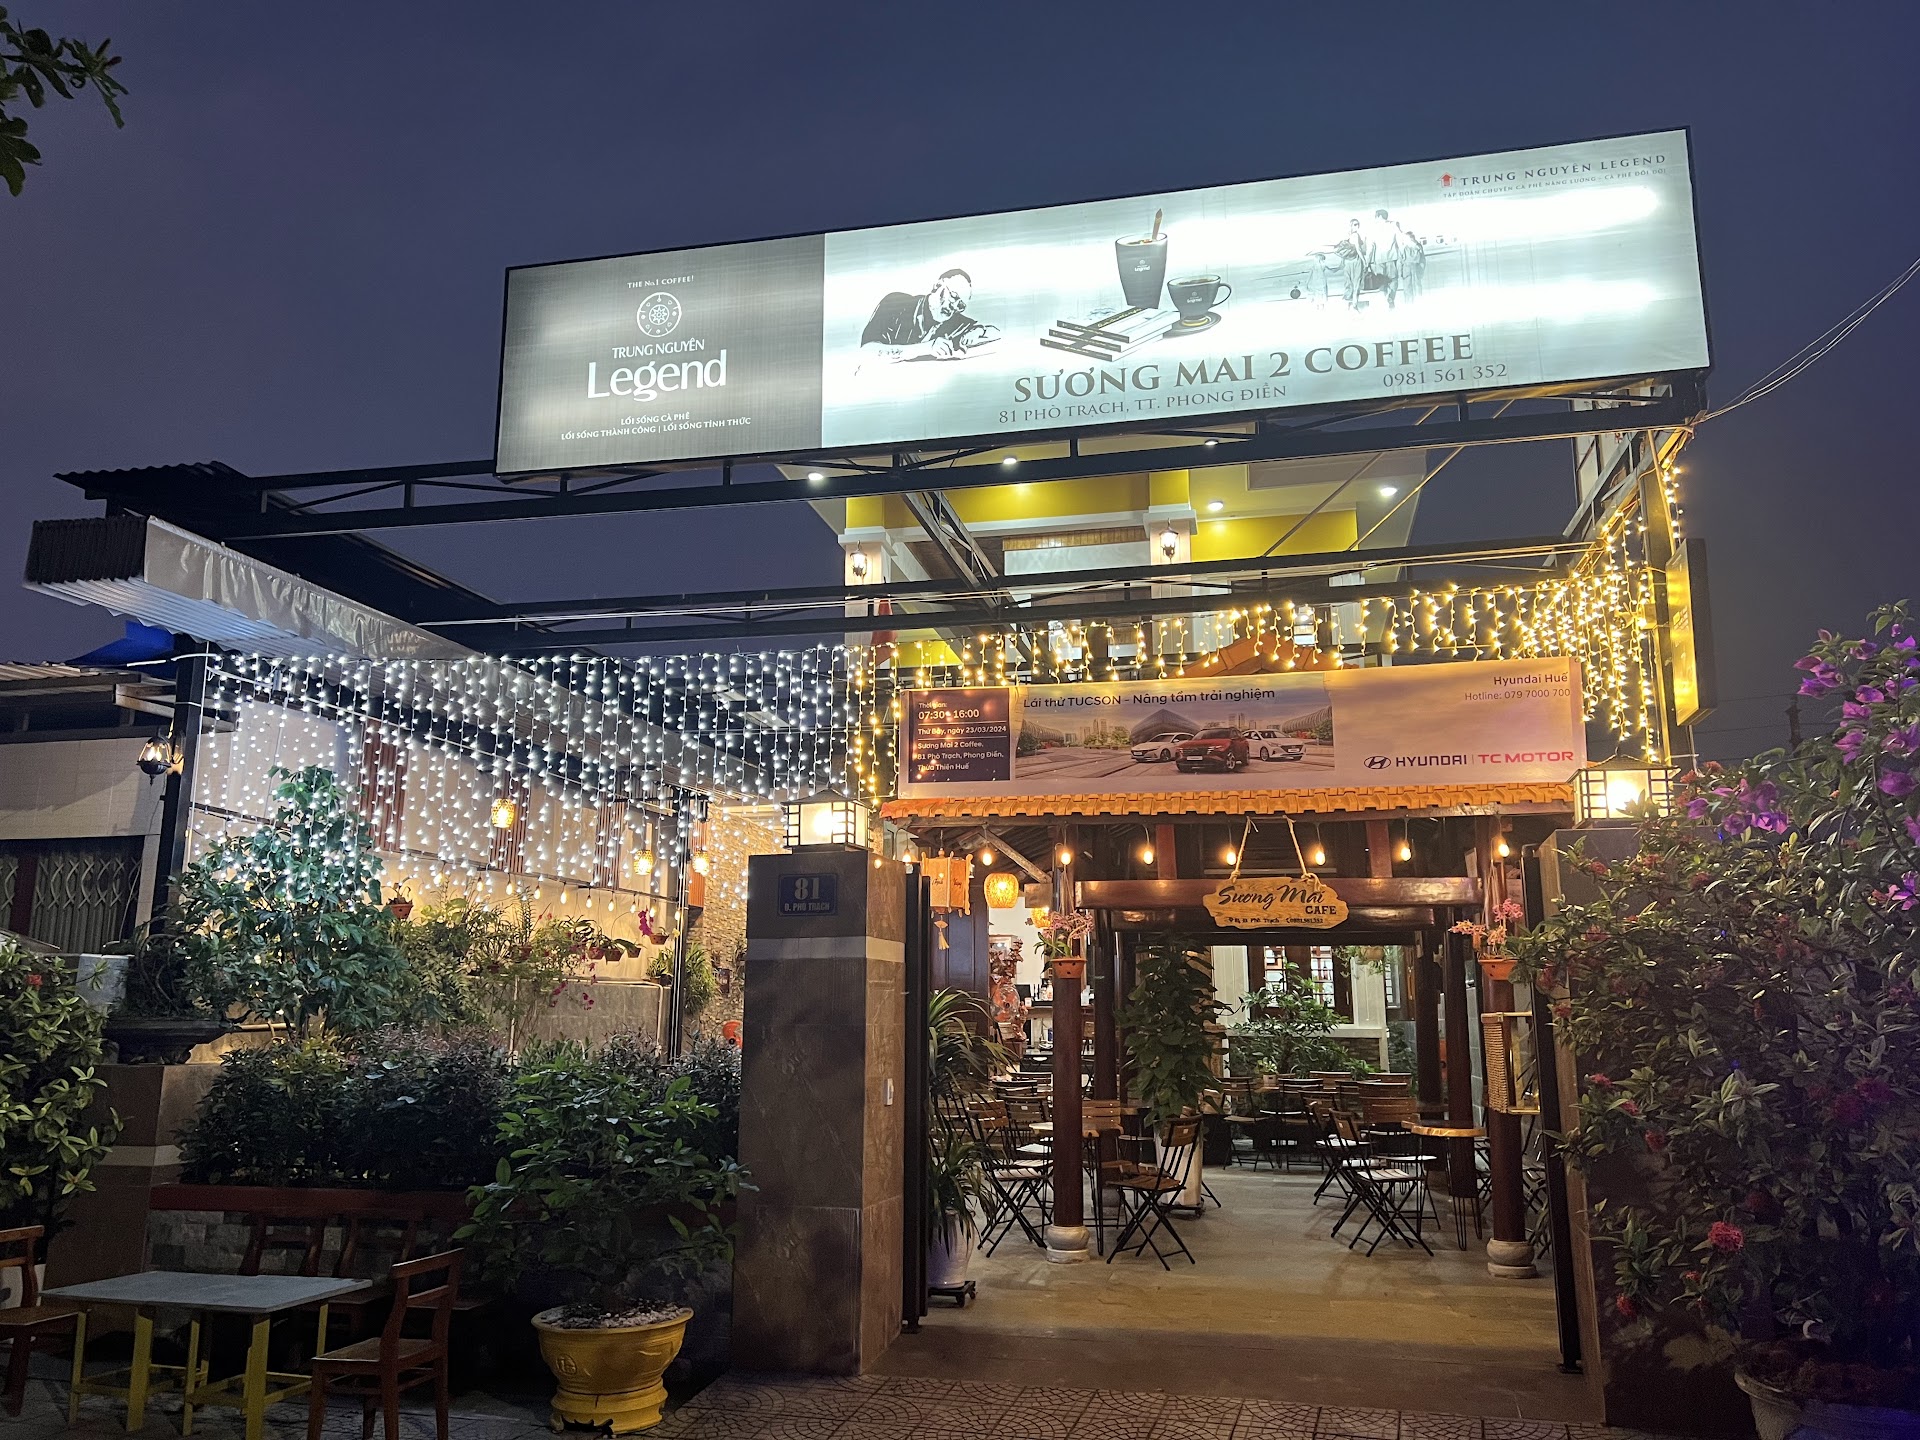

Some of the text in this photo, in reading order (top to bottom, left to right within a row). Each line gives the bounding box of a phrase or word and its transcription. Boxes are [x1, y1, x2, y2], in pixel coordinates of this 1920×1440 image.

[1461, 155, 1666, 186] TRUNG NGUYÊN LEGEND
[627, 281, 642, 289] THE
[661, 275, 694, 285] COFFEE!
[612, 337, 705, 359] TRUNG NGUYÊN
[587, 349, 727, 402] Legend
[1014, 334, 1473, 403] SƯƠNG MAI 2 COFFEE
[1383, 363, 1508, 387] 0981 561 352
[999, 410, 1017, 424] 81
[1024, 404, 1061, 421] PHÒ
[1065, 400, 1129, 418] TRẠCH,
[1134, 398, 1160, 411] TT.
[1166, 391, 1234, 408] PHONG
[636, 414, 660, 424] SỐNG
[660, 413, 672, 422] CÀ
[674, 411, 690, 420] PHÊ
[576, 429, 599, 439] SỐNG
[600, 427, 630, 437] THÀNH
[631, 425, 656, 434] CÔNG
[678, 420, 702, 430] SỐNG
[1494, 671, 1568, 686] Hyundai Huế
[1024, 698, 1041, 708] Lái
[1044, 696, 1066, 707] thử
[1068, 695, 1121, 706] TUCSON
[1133, 693, 1167, 705] Nâng
[1200, 689, 1222, 701] trải
[1225, 688, 1275, 702] nghiệm
[1465, 688, 1571, 701] Hotline: 079 7000 700
[918, 709, 980, 720] 07:30 16:00
[965, 726, 1006, 734] 23/03/2024
[963, 752, 985, 760] Phong
[1396, 754, 1467, 767] HYUNDAI
[1478, 751, 1574, 764] TC MOTOR
[794, 877, 820, 900] 81
[1277, 885, 1326, 904] Mai
[1305, 905, 1337, 915] CAFE
